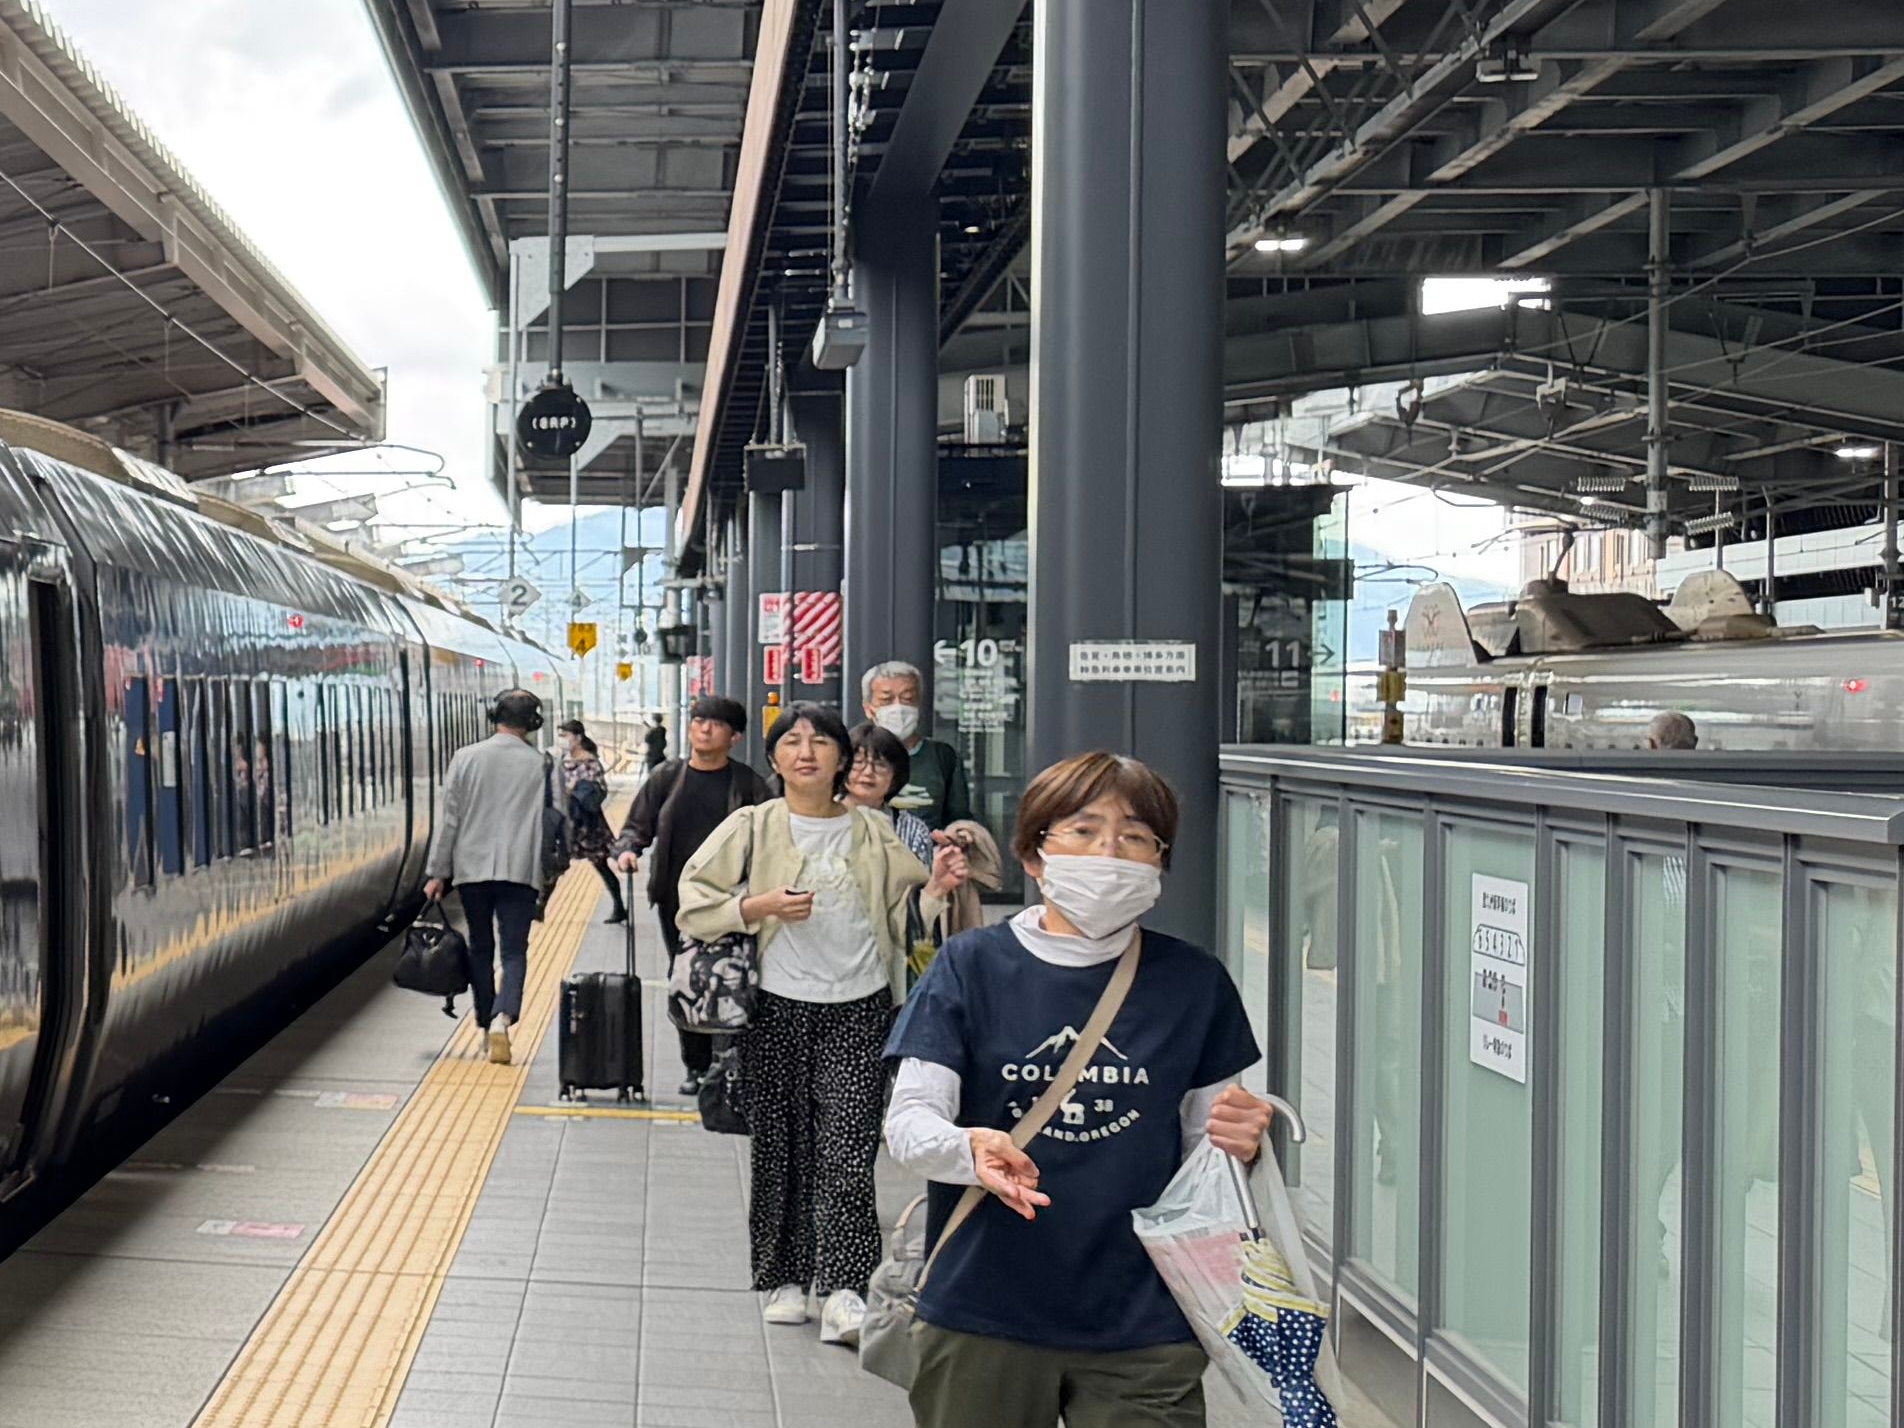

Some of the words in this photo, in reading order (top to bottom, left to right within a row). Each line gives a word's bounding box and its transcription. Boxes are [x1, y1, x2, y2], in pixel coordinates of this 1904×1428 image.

[511, 585, 527, 606] 2
[959, 638, 998, 667] 10
[1265, 640, 1300, 668] 11
[1001, 1063, 1150, 1085] COLMBIA
